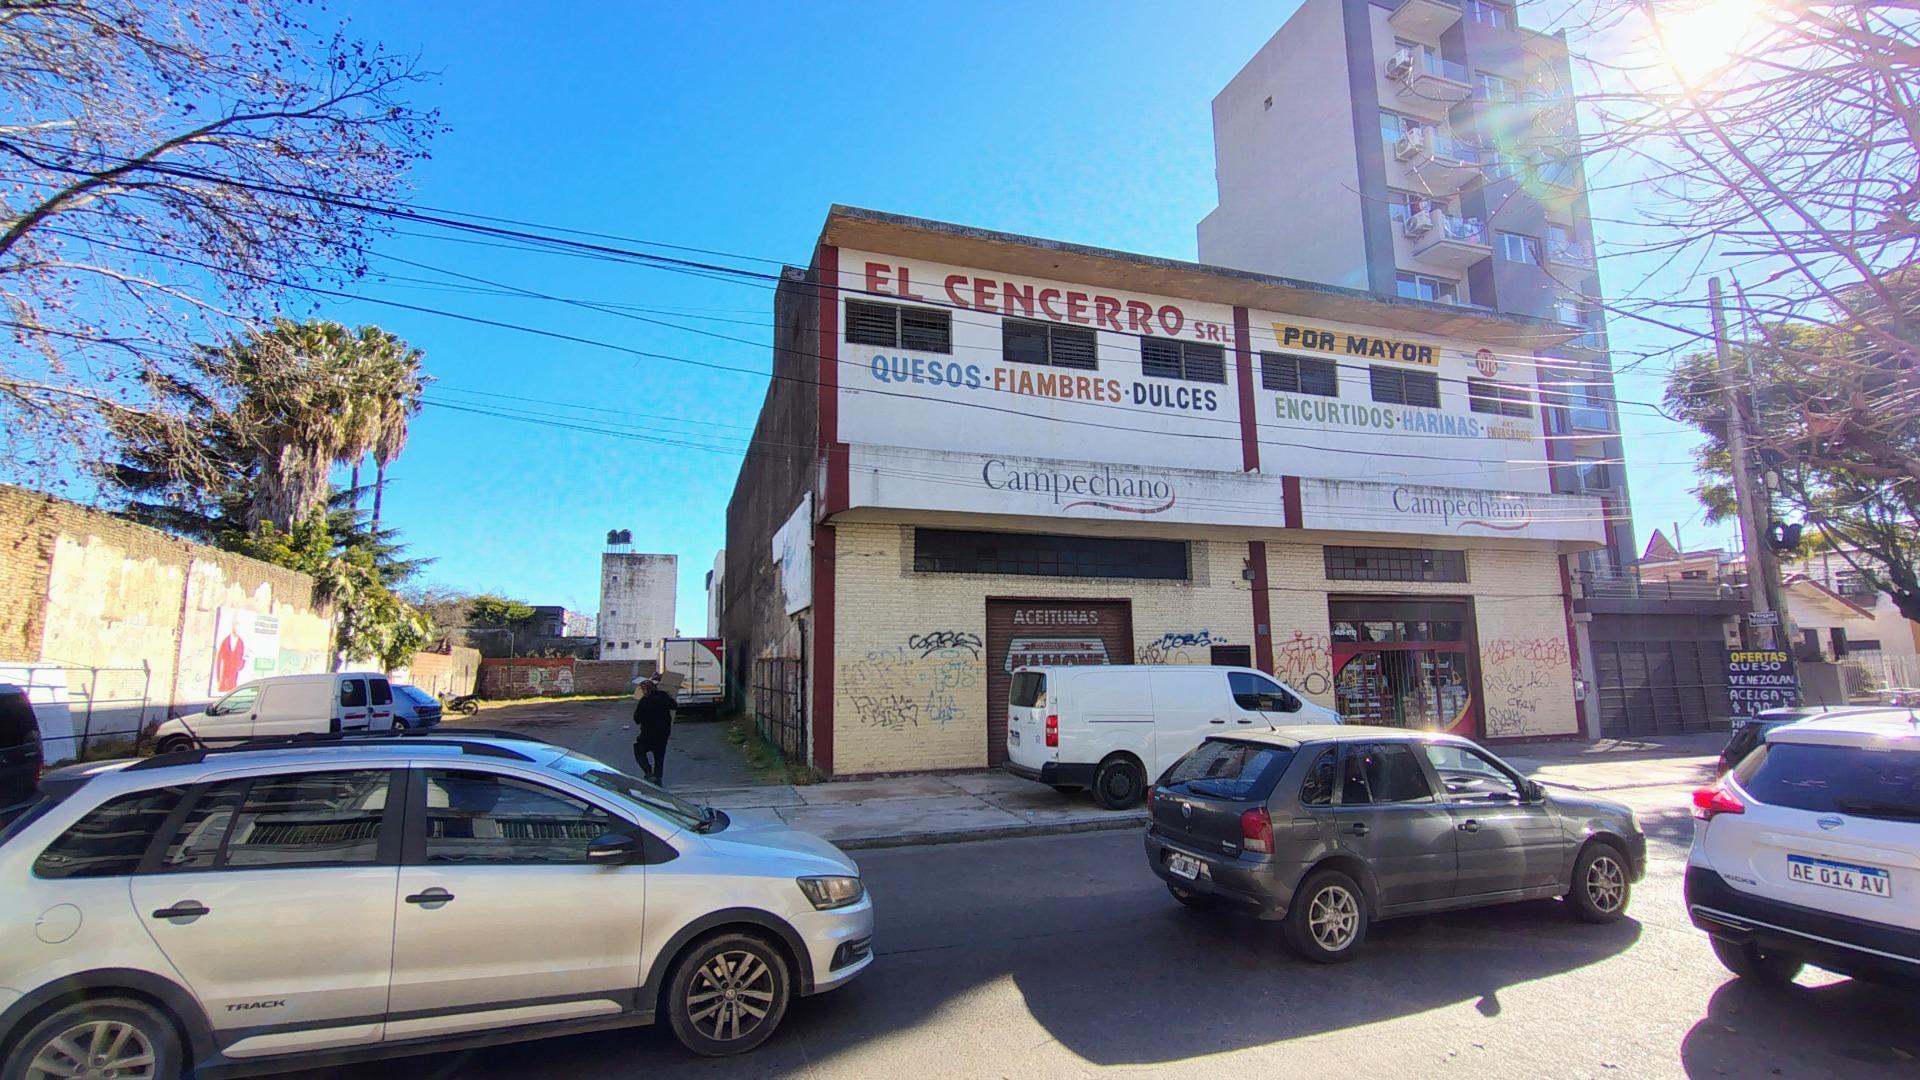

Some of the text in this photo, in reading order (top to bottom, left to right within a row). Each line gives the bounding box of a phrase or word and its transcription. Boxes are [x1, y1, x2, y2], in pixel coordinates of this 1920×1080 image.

[865, 262, 923, 300] EL
[944, 274, 1184, 336] CENCERRO
[1284, 326, 1432, 363] POR MAYOR
[1477, 353, 1497, 373] 1978
[872, 355, 1217, 411] QUESOS FIAMBRES DULCES
[1275, 397, 1479, 437] ENCURTIDOS HARINAS
[982, 459, 1169, 503] Campechano
[1393, 487, 1524, 526] Campechano
[1013, 609, 1099, 625] ACEITUNAS
[1729, 662, 1781, 671] QUESO
[1731, 651, 1787, 663] OFERTAS
[1729, 689, 1779, 701] ACELGA
[1792, 864, 1813, 881] AE
[1820, 869, 1854, 888] 014
[1860, 875, 1884, 894] AV
[226, 999, 287, 1012] TRACK
